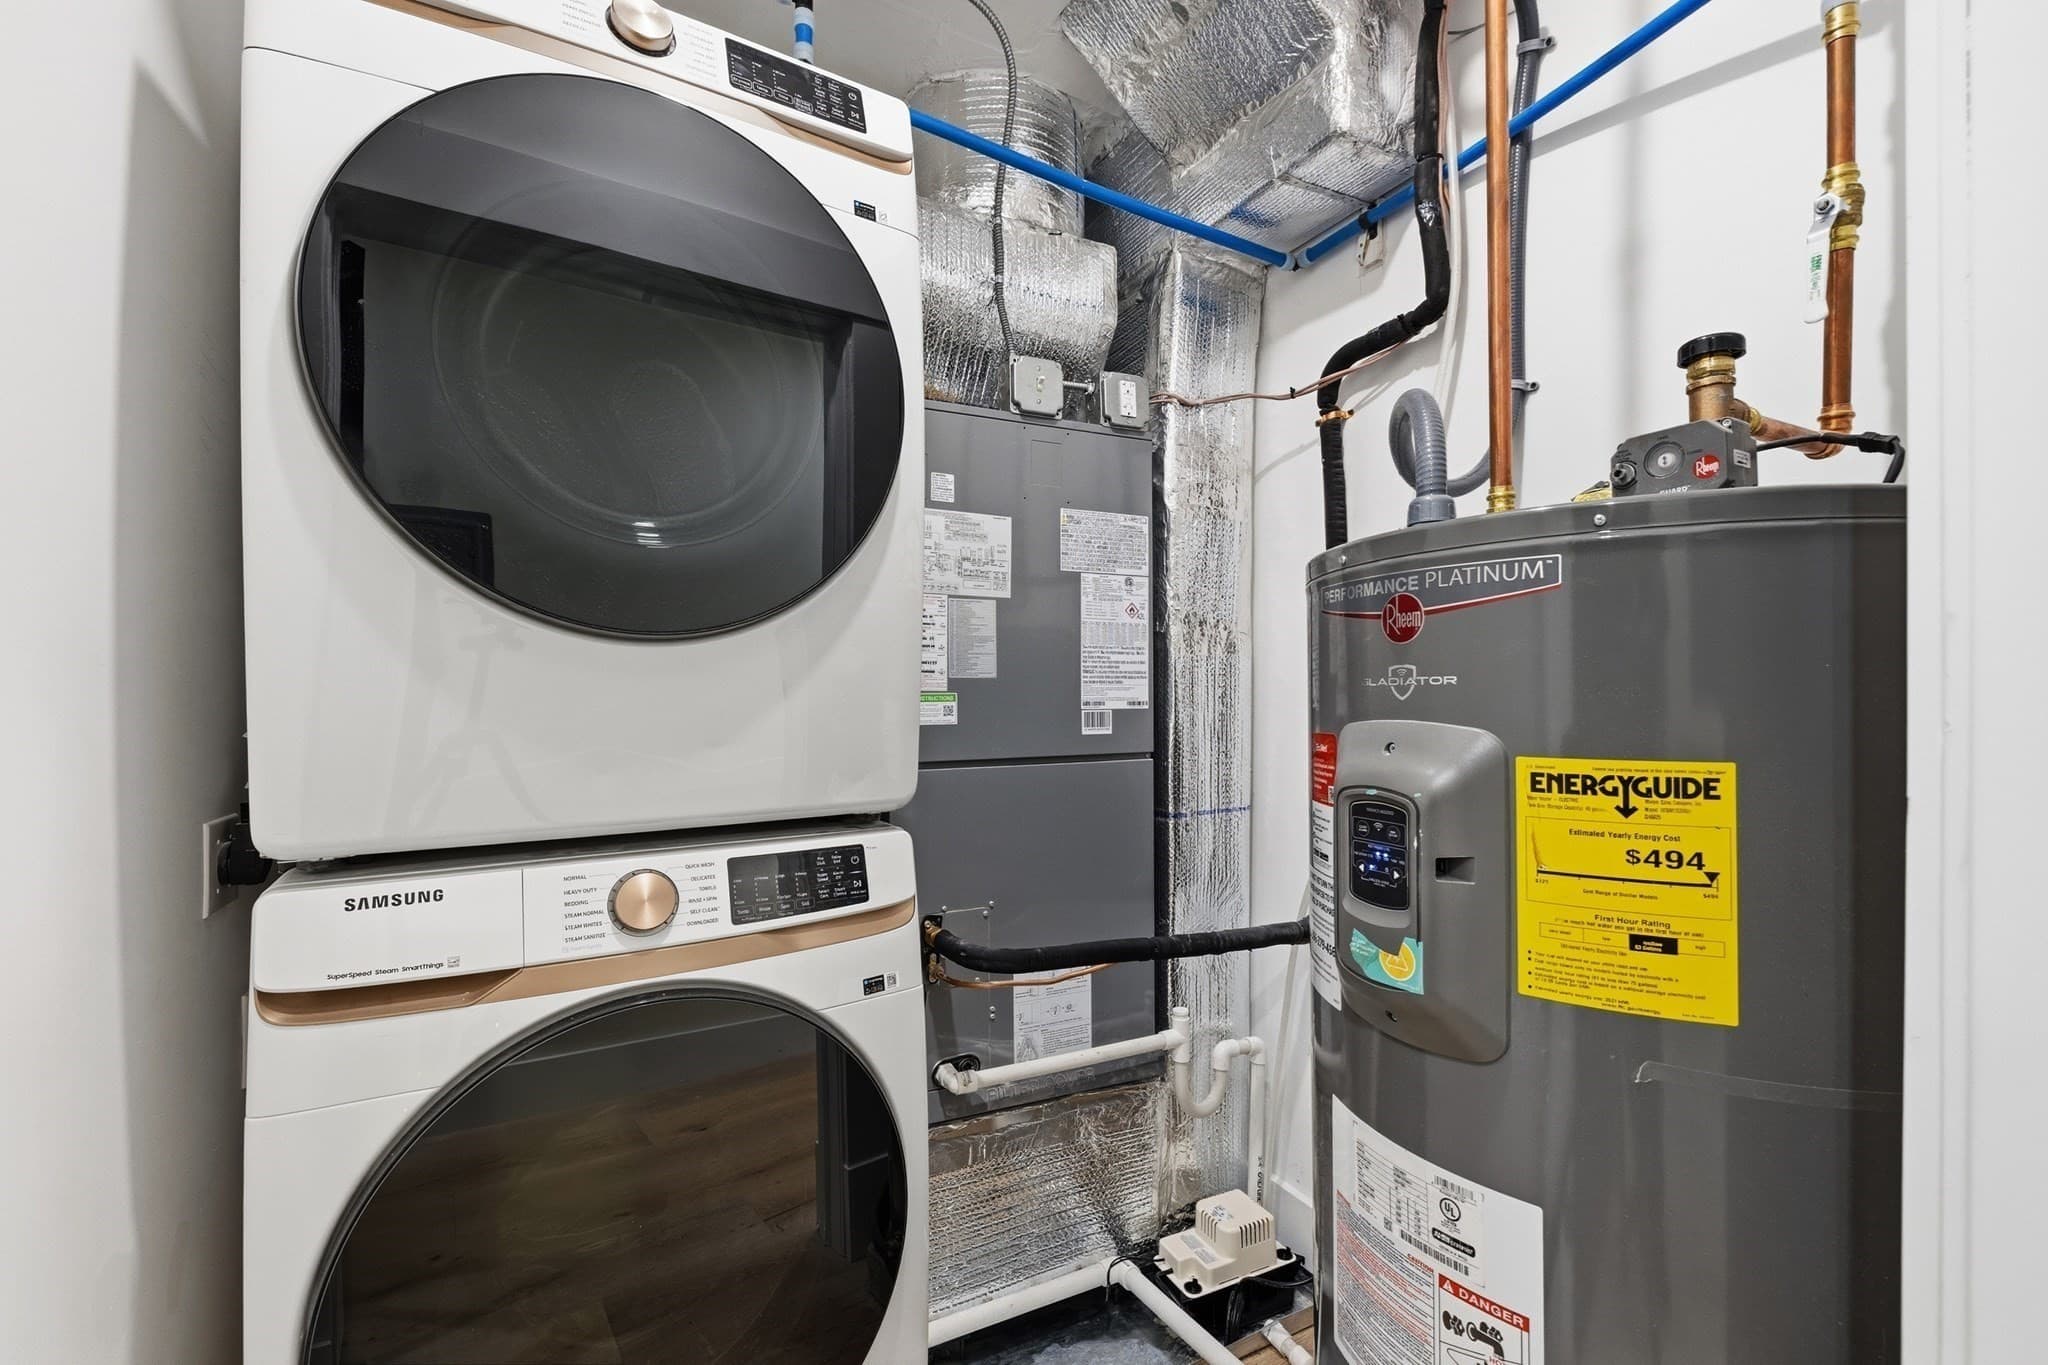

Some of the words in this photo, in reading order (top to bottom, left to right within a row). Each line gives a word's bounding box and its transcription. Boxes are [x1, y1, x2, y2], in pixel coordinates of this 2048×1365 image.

[1324, 575, 1419, 605] PERFORMANCE
[1386, 594, 1421, 635] Rheem
[1530, 772, 1721, 801] ENERGYGUIDE
[1569, 828, 1605, 838] Estimated
[1608, 832, 1631, 840] Yearly
[1634, 833, 1661, 842] Energy
[1663, 834, 1680, 842] Cost
[1625, 849, 1706, 871] $494
[344, 889, 444, 912] SAMSUNG
[1594, 914, 1614, 922] First
[1617, 917, 1638, 925] Hour
[1641, 919, 1671, 929] Rating
[584, 932, 606, 940] SANITIZE
[327, 970, 372, 981] SuperSpeed
[375, 967, 399, 975] Steam
[402, 961, 444, 972] SmartThings
[1444, 1201, 1456, 1218] UL
[1458, 1288, 1524, 1328] DANGER
